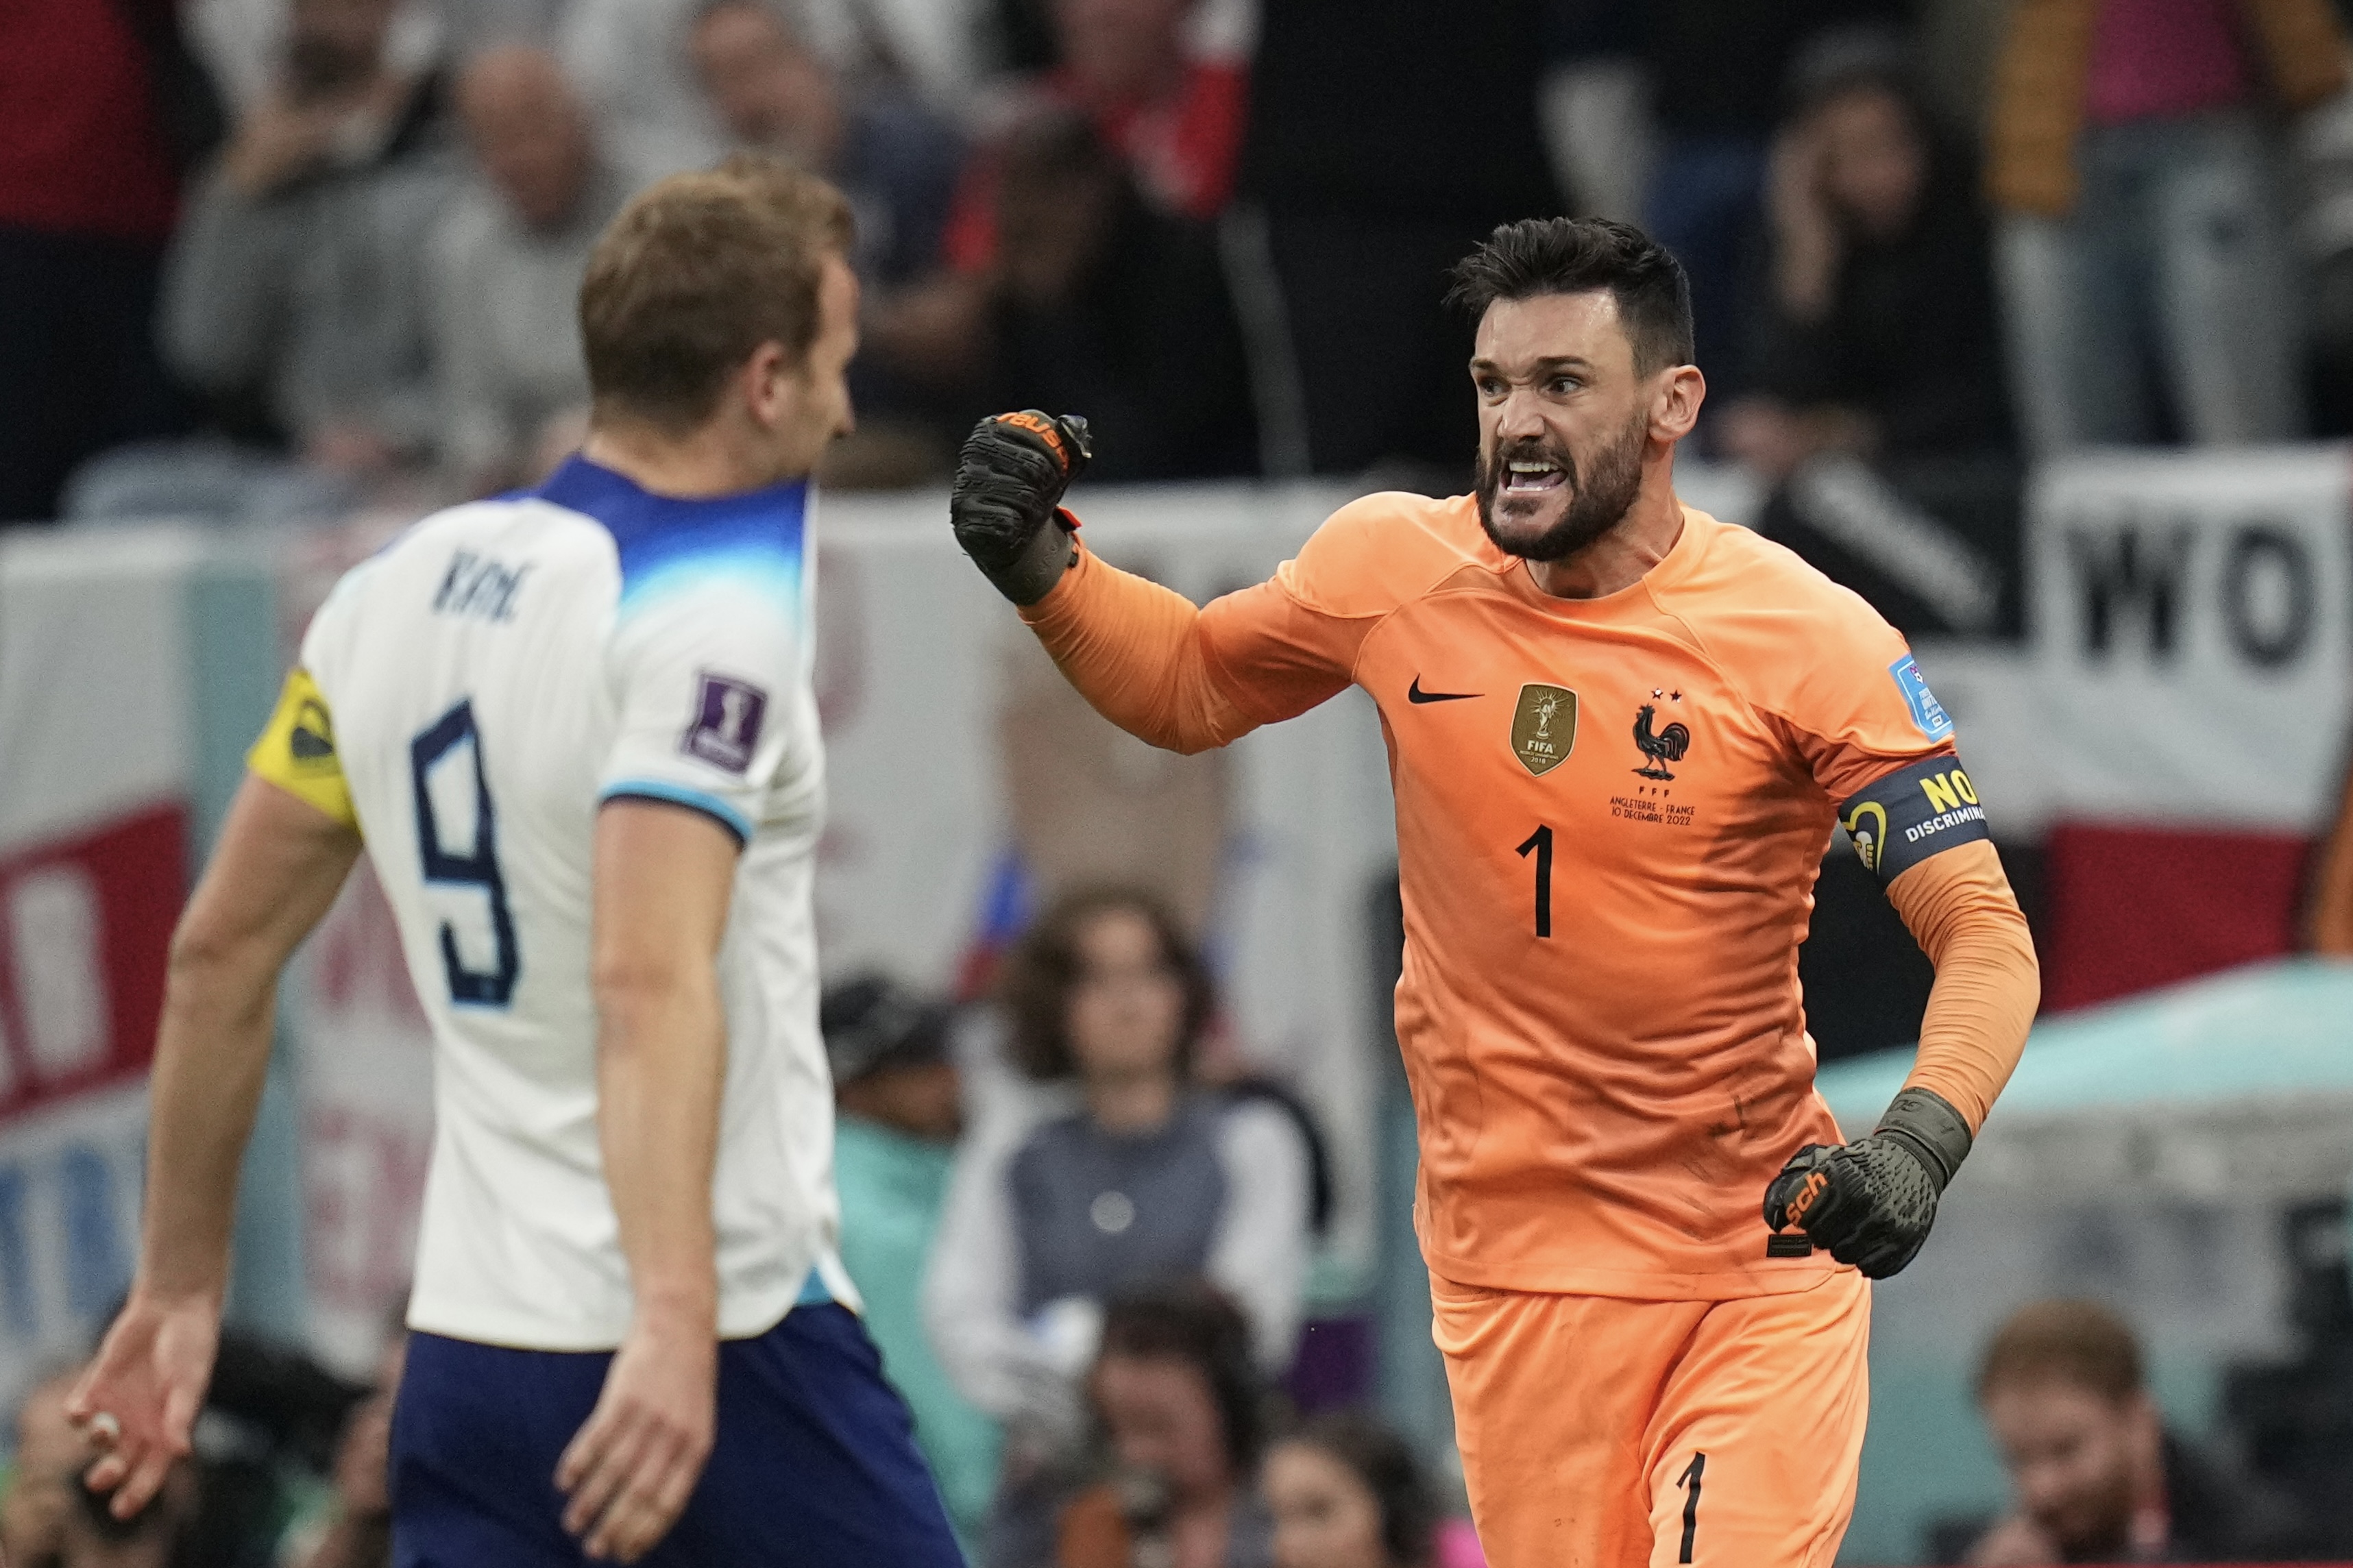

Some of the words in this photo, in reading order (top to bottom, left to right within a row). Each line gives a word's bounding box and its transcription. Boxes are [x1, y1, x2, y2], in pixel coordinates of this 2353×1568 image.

[1527, 739, 1553, 755] FIFA
[1610, 796, 1657, 812] ANGLETERRE
[1666, 804, 1696, 816] FRANCE
[1919, 769, 1978, 814] NO
[1666, 815, 1691, 826] 2022
[413, 698, 519, 1005] 9
[1515, 823, 1552, 938] 1
[1676, 1451, 1706, 1564] 1
